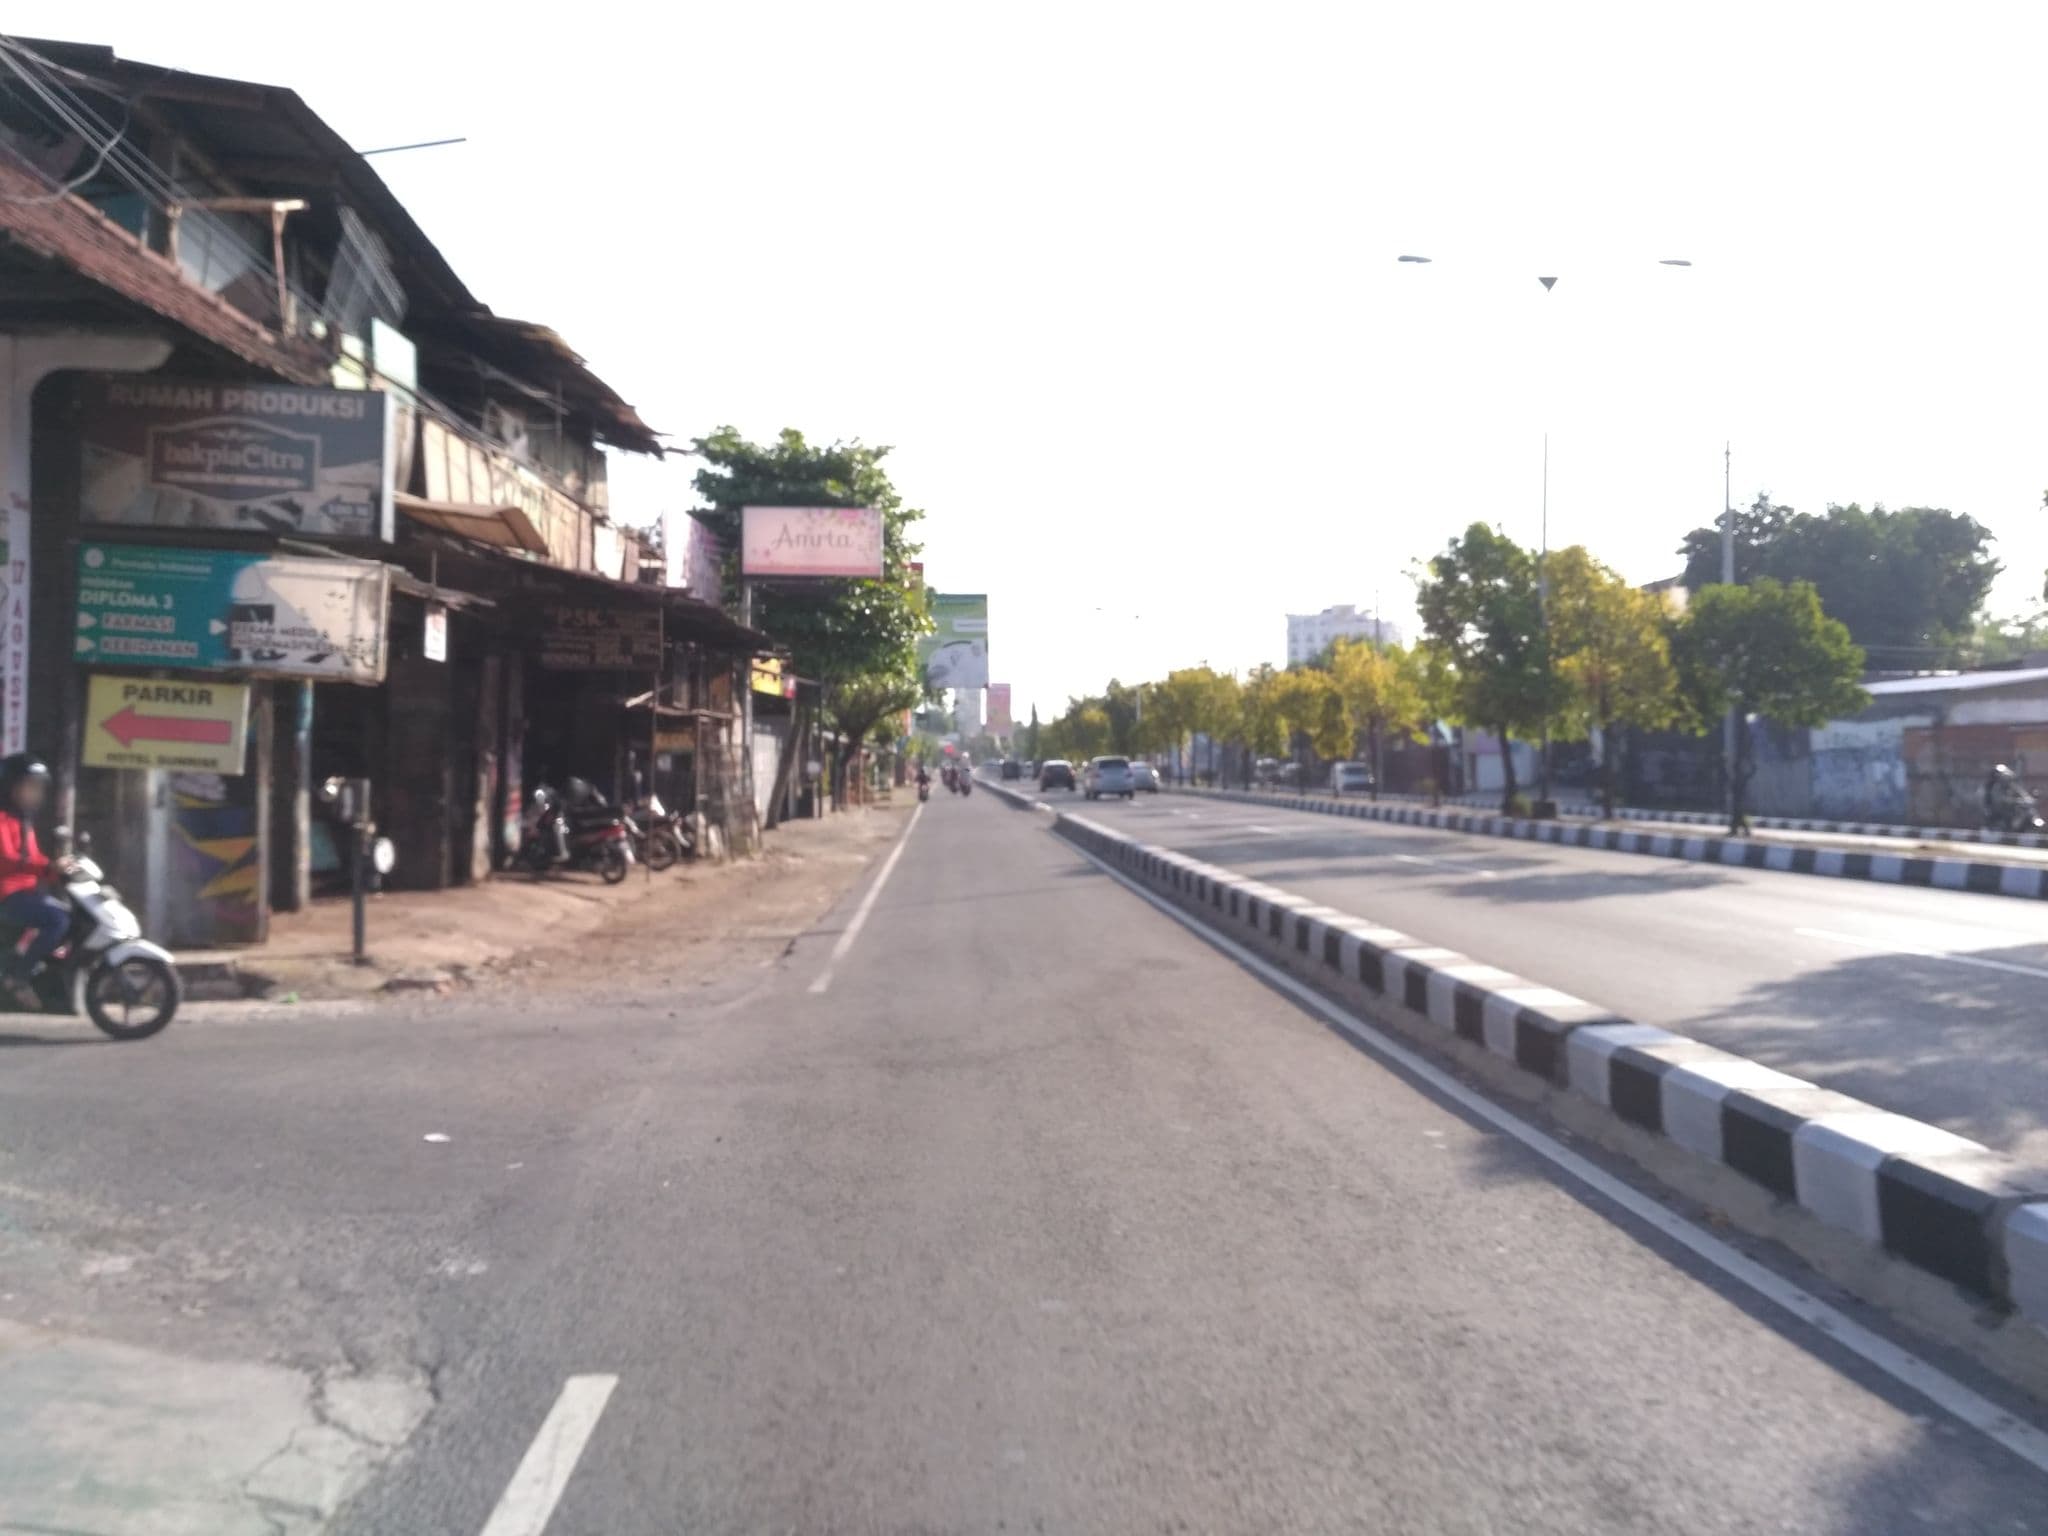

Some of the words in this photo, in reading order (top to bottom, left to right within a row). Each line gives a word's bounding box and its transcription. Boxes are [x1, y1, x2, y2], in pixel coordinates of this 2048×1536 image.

[107, 384, 212, 409] RUMAH
[223, 388, 364, 418] PRODUKSI
[80, 590, 158, 608] DIPLOMA
[161, 593, 174, 610] 3
[104, 613, 175, 632] FARMASI
[101, 637, 198, 657] KEBIDANAN
[122, 684, 213, 705] PARKIR
[106, 752, 151, 764] HOTEL
[156, 755, 219, 768] SUNRISE
